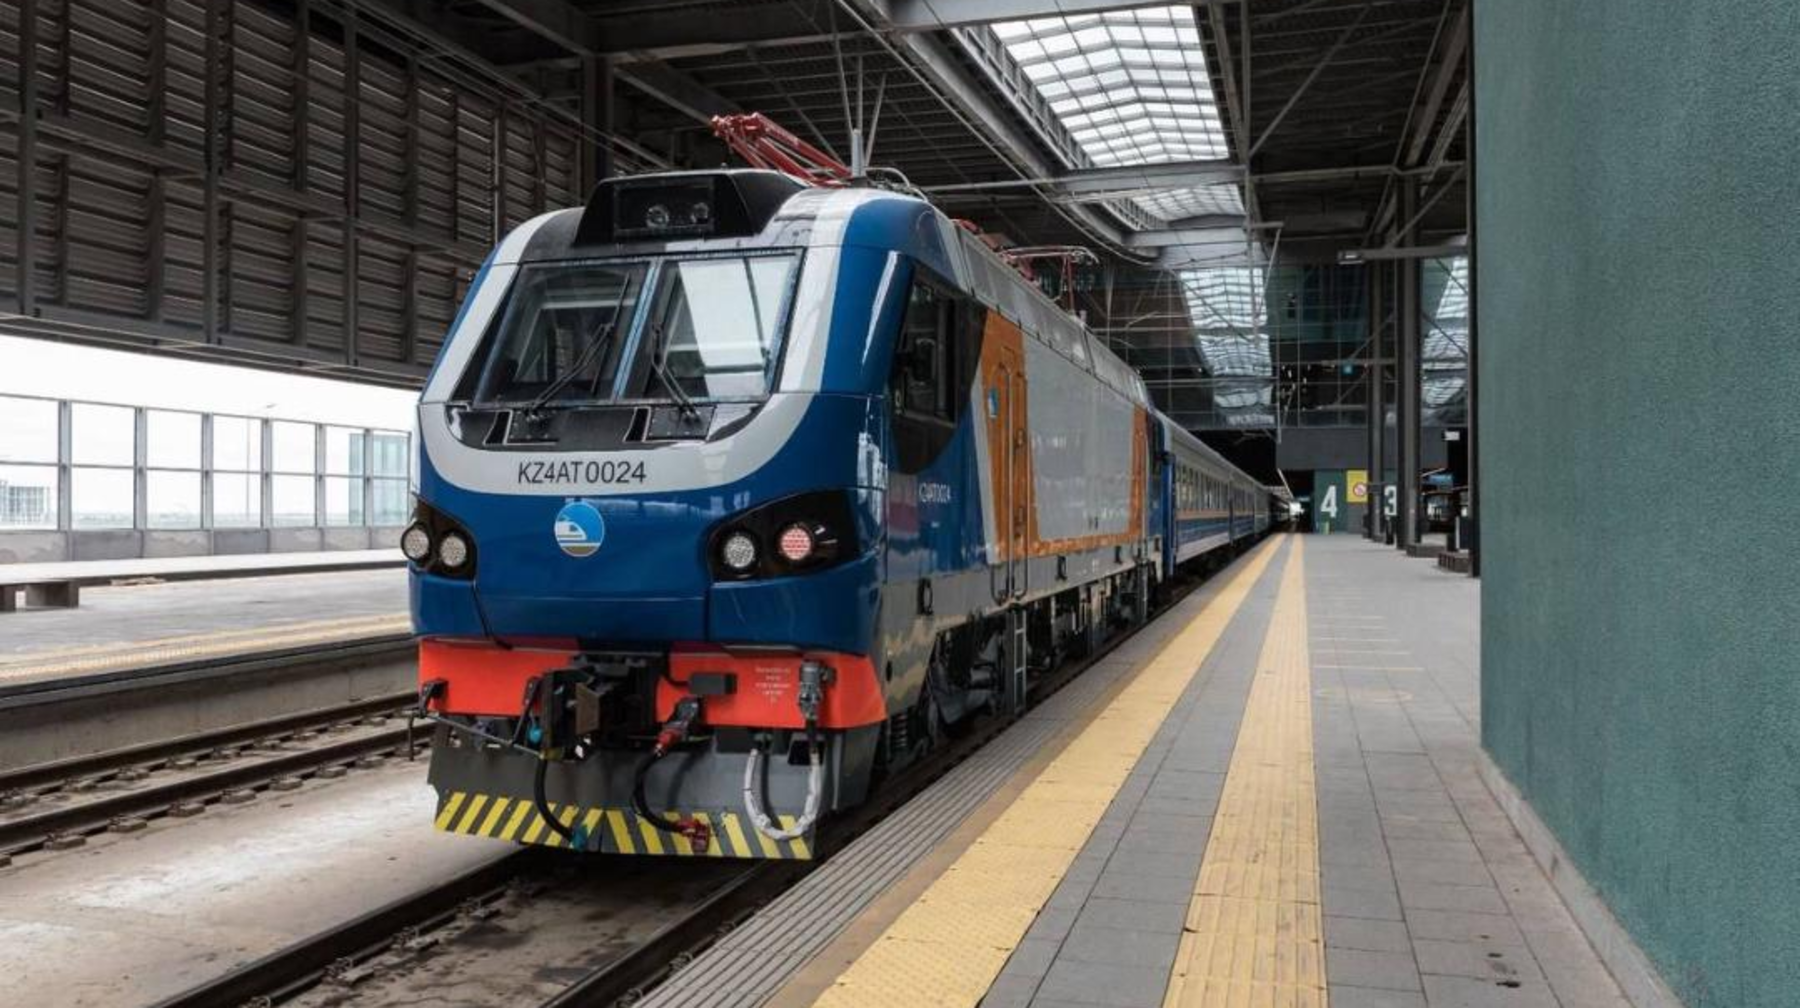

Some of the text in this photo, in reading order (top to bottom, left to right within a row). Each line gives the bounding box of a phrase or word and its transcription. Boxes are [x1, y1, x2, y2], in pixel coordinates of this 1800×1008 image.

[517, 460, 647, 484] KZ4AT0024
[1320, 485, 1338, 518] 4
[1383, 485, 1398, 516] 3
